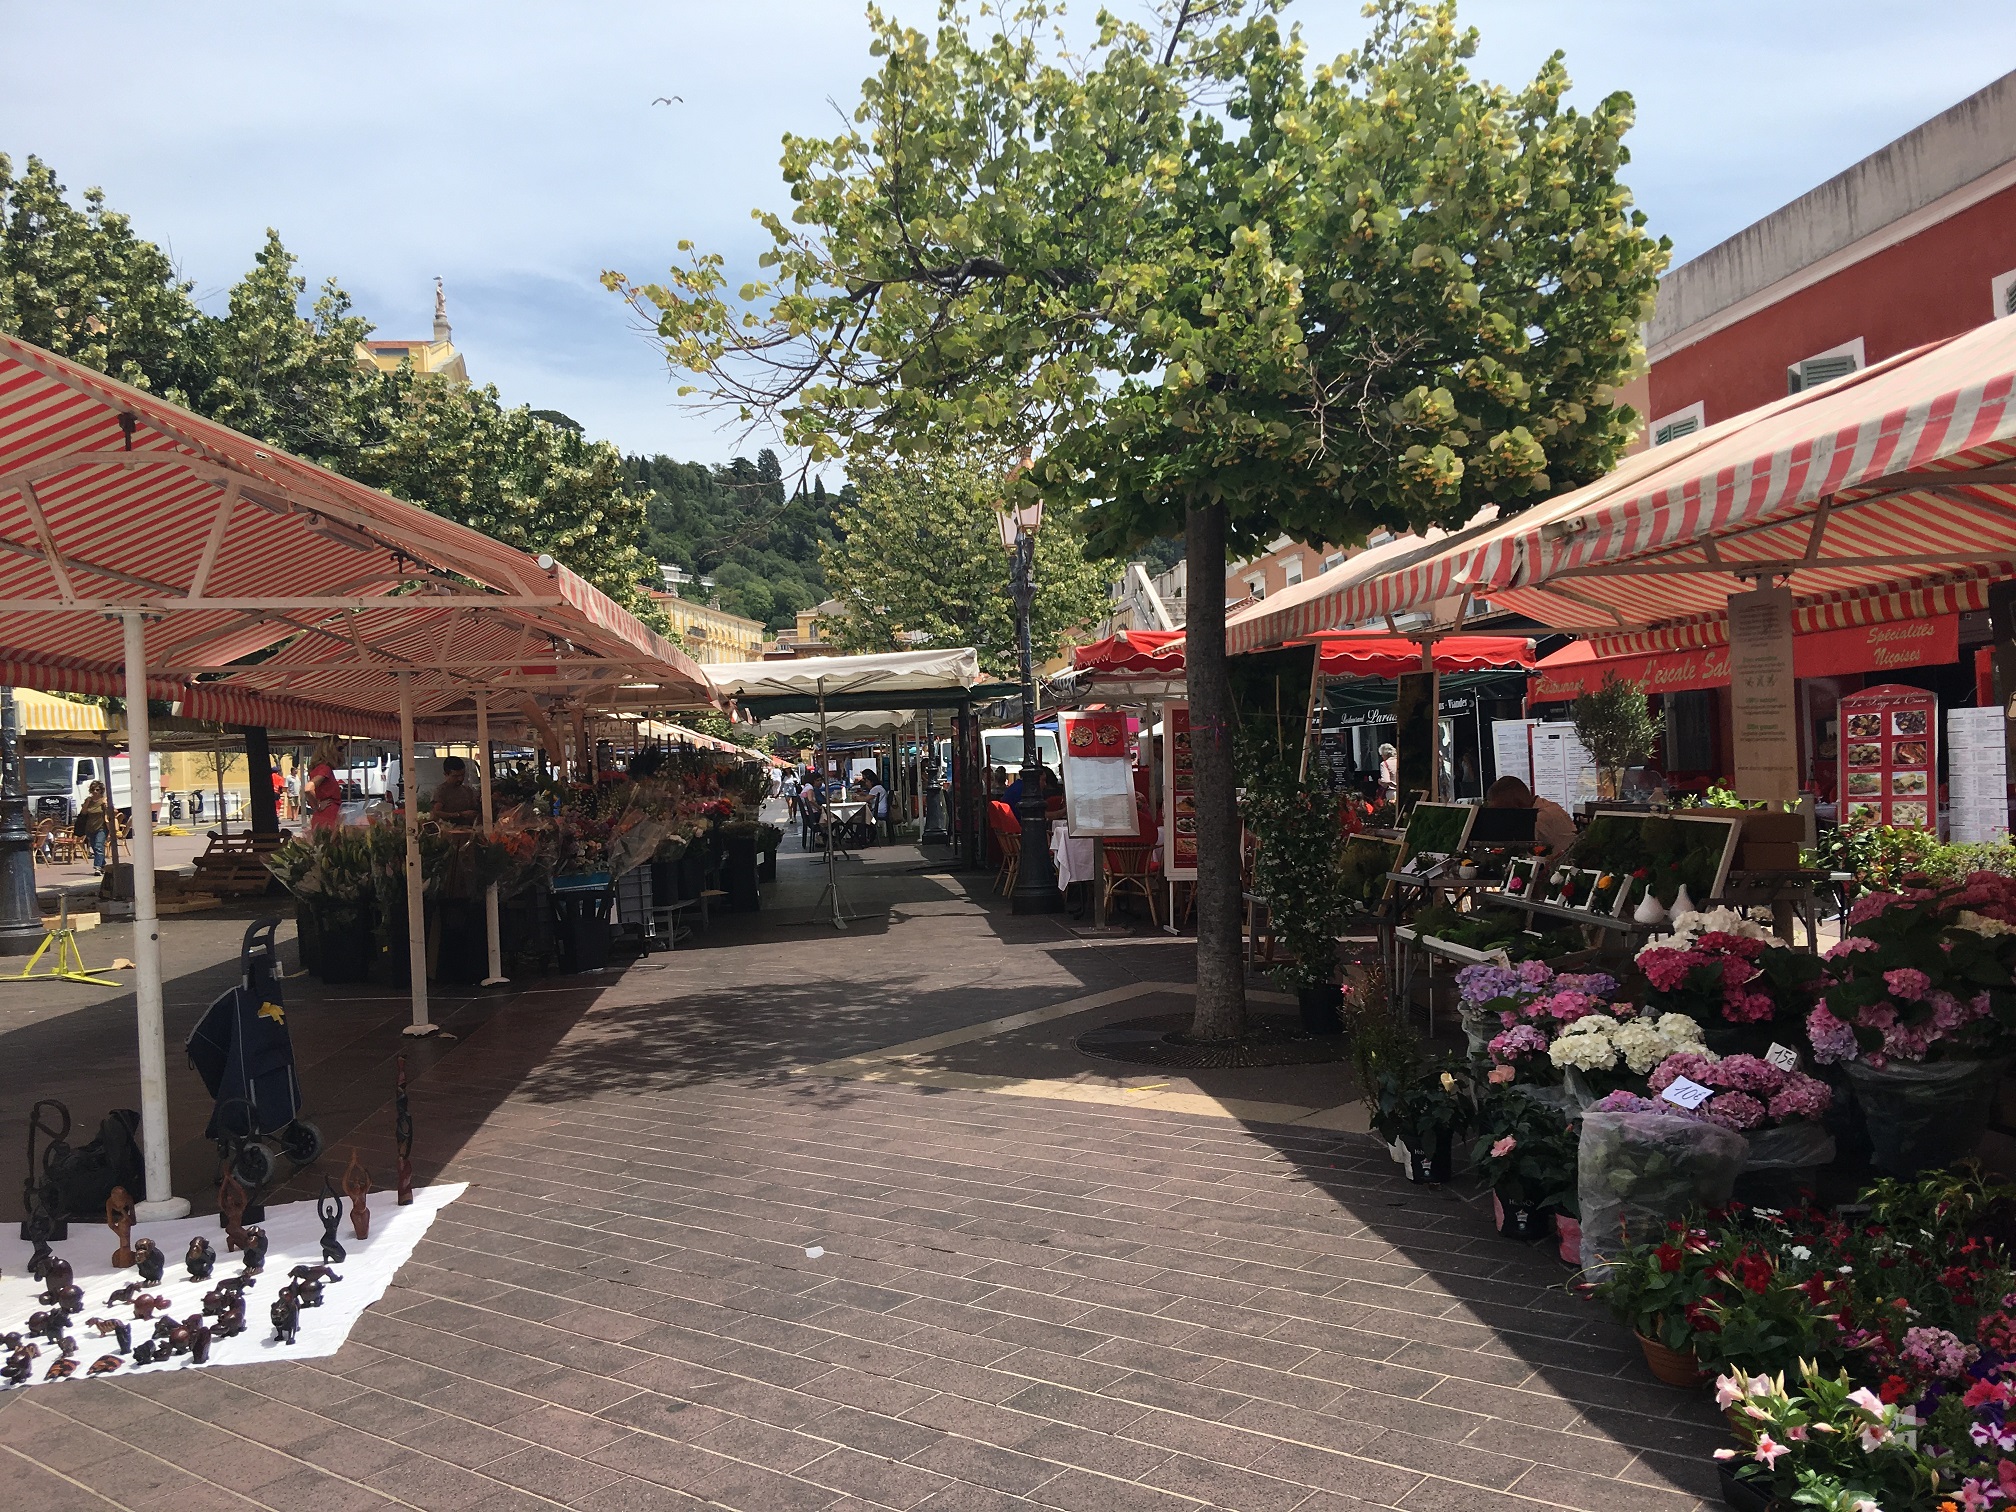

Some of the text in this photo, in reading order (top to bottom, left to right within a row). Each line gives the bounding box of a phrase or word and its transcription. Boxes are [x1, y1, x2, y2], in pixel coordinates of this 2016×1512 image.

[1866, 623, 1936, 645] Spécialités
[1873, 647, 1921, 667] Niçoises
[1535, 677, 1585, 696] Restaurant
[1774, 1048, 1793, 1066] 15€
[1673, 1085, 1705, 1101] 10€
